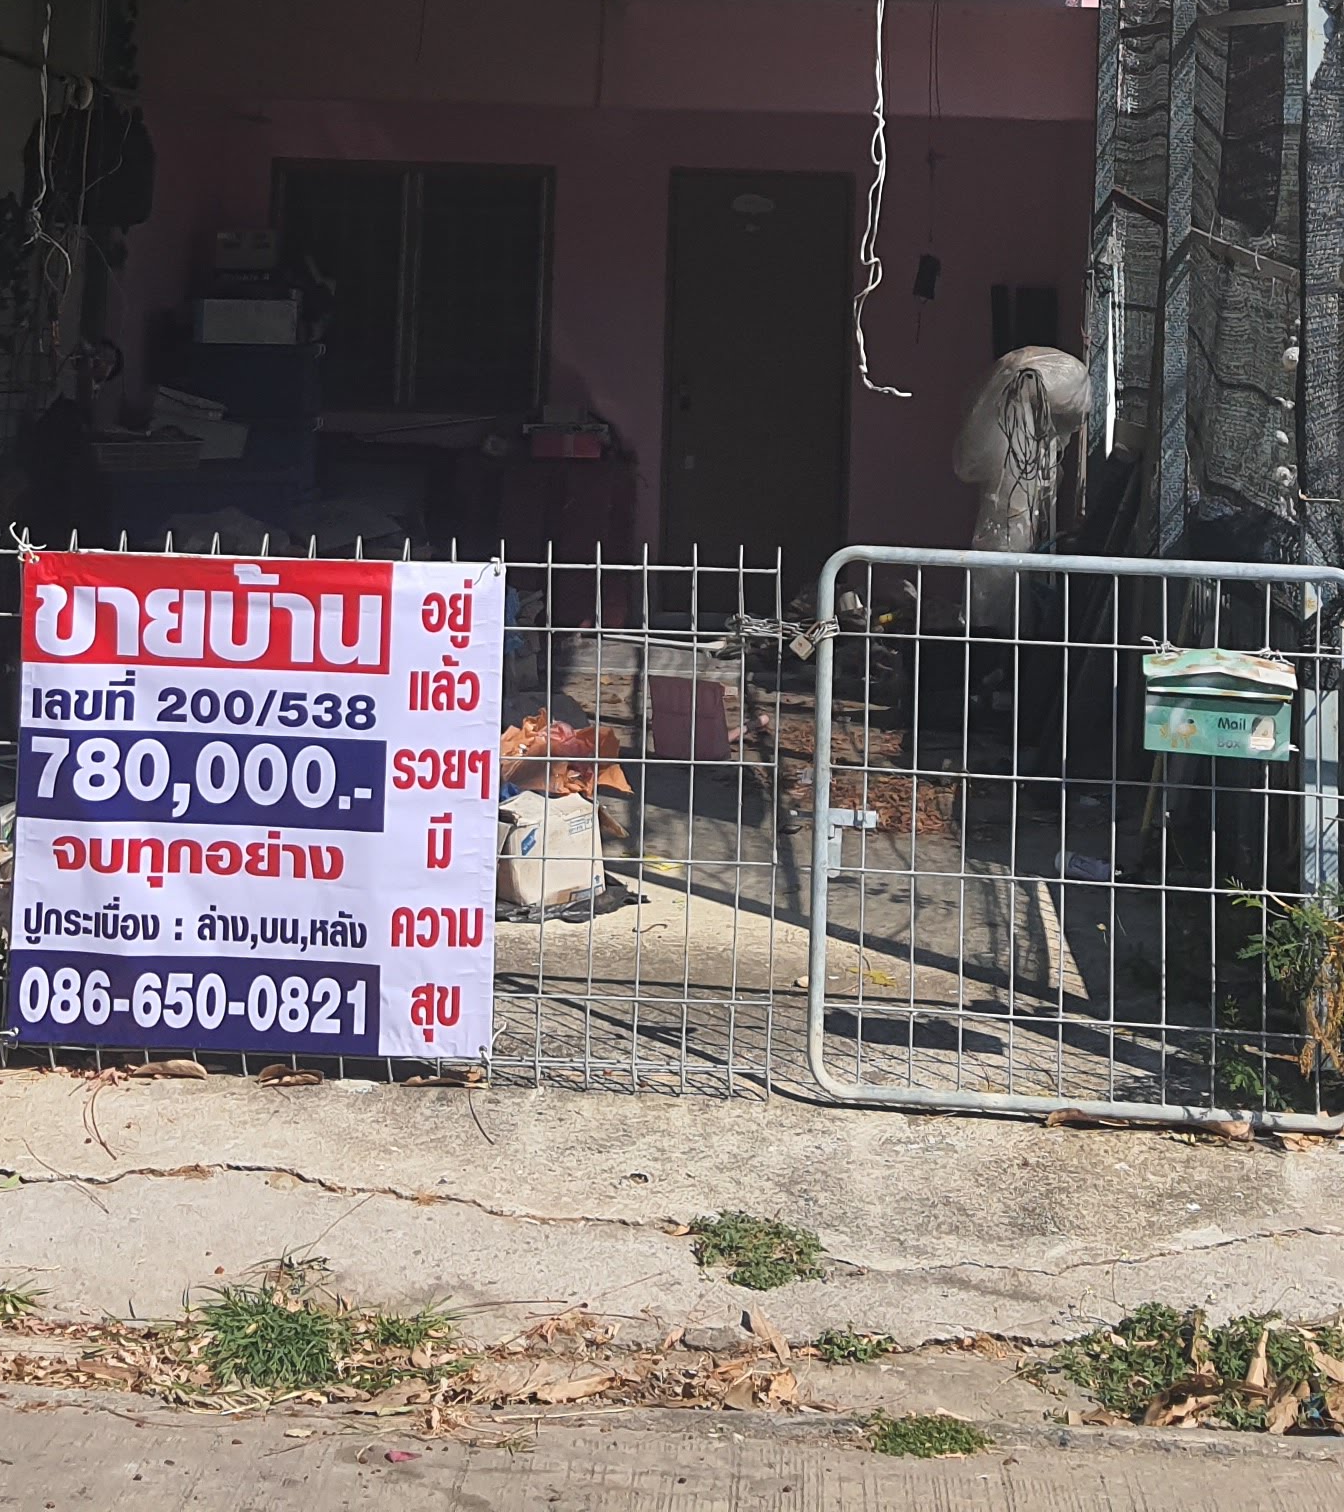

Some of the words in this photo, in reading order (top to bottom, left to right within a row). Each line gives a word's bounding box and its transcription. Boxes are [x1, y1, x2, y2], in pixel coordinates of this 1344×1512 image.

[32, 563, 384, 666] ขายบ้าน
[421, 579, 474, 648] อยู่
[31, 670, 136, 722] เลขที่
[157, 687, 377, 731] 200/538
[408, 655, 481, 713] แล้ว
[1217, 716, 1246, 731] Mail
[30, 735, 373, 817] 780,000.-
[392, 748, 491, 800] รวยๆ
[52, 831, 345, 888] จบทุกอย่าง
[426, 812, 453, 870] มี
[196, 906, 368, 952] ล่าง,บน,หลัง
[391, 906, 484, 949] ความ
[18, 966, 368, 1036] 086-650-0821
[410, 982, 462, 1043] สุข
